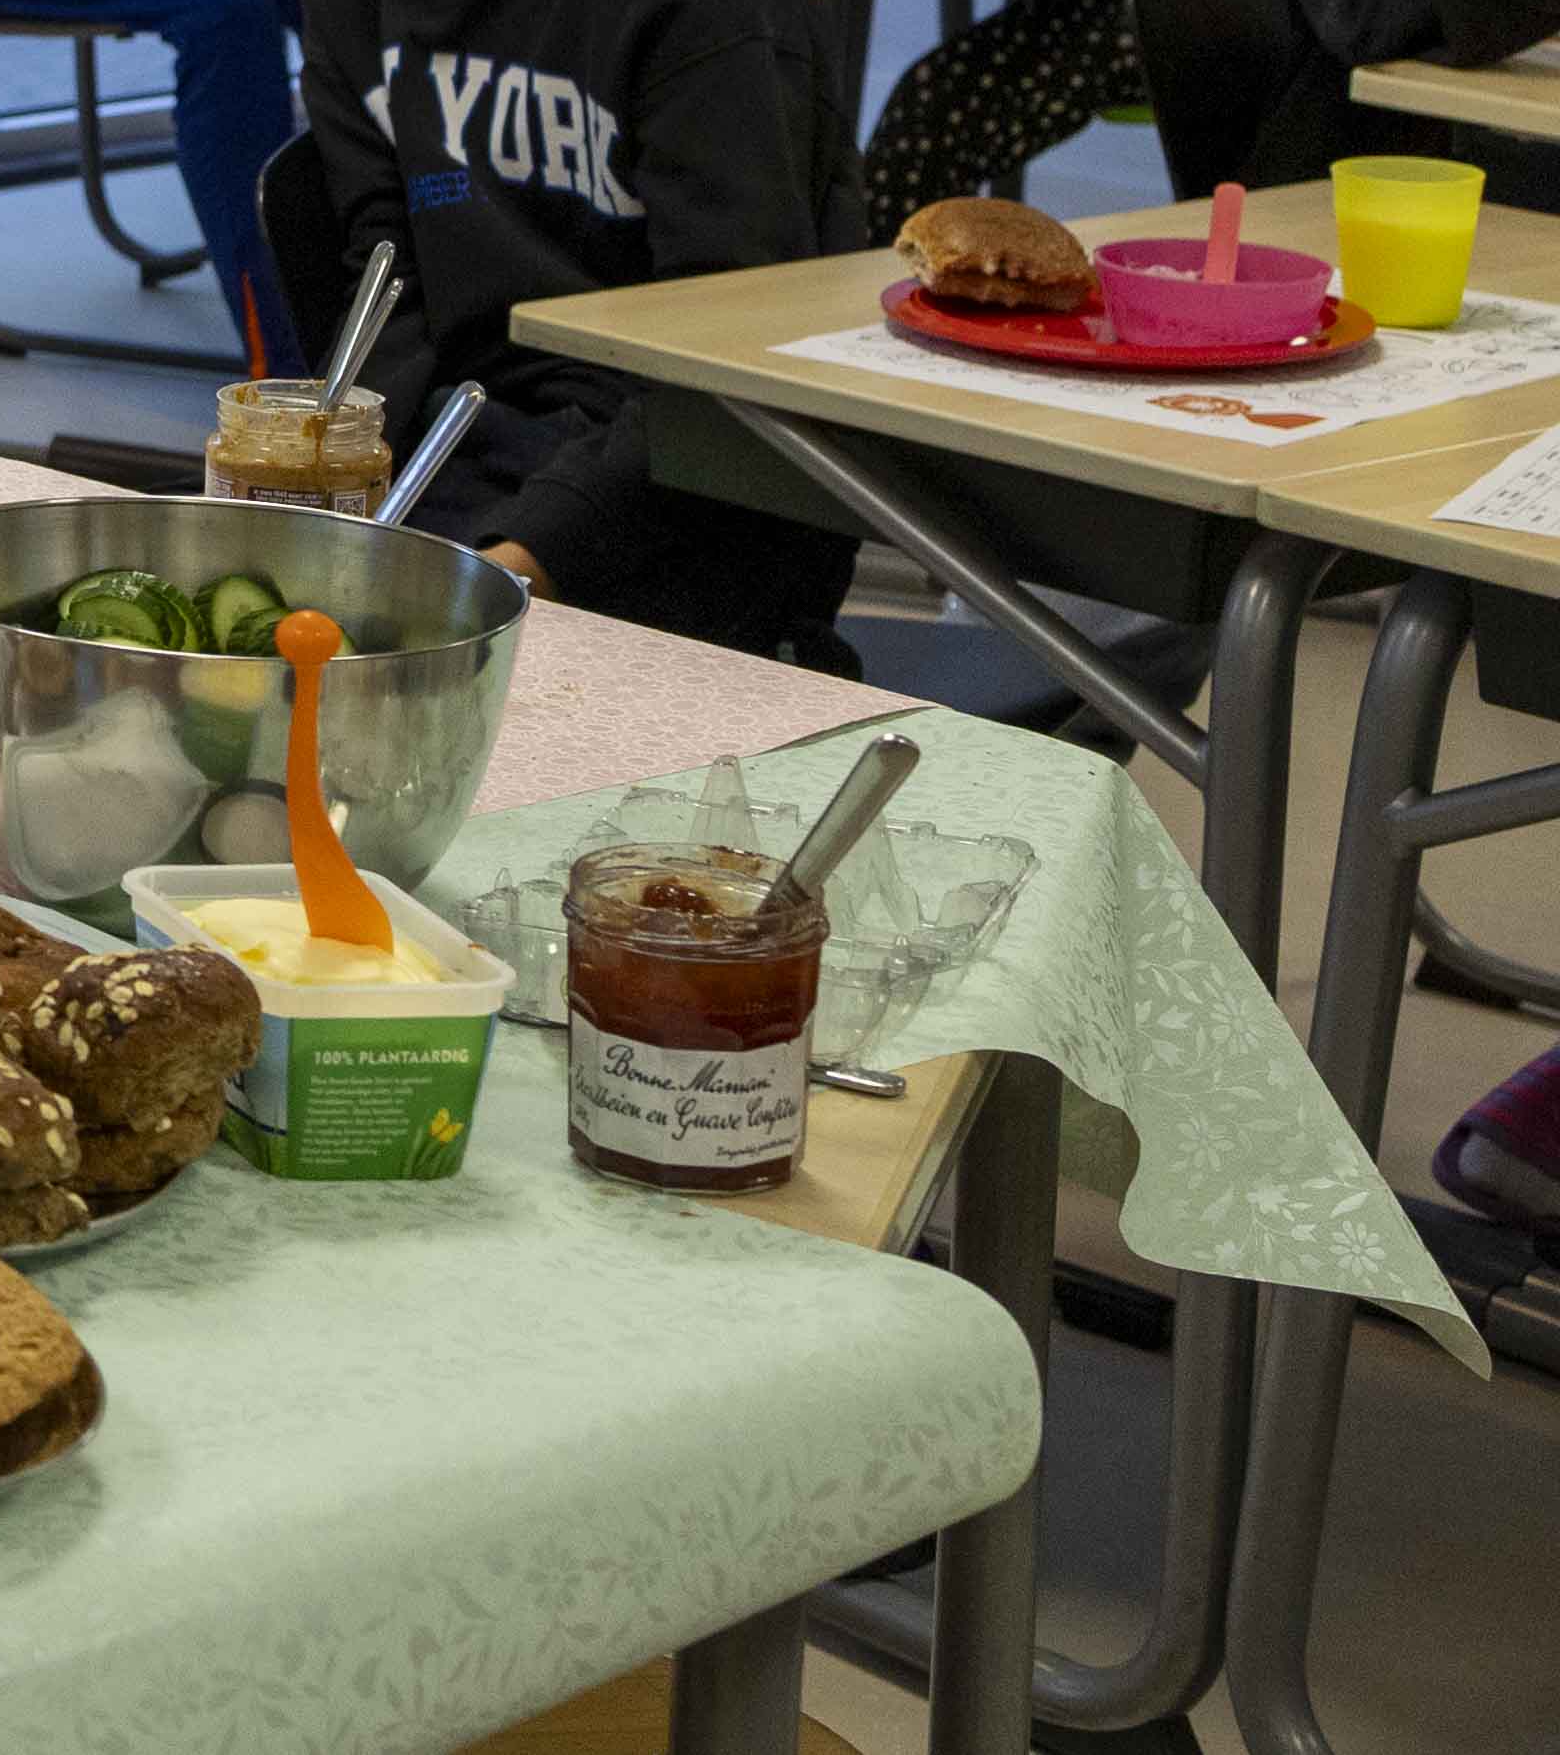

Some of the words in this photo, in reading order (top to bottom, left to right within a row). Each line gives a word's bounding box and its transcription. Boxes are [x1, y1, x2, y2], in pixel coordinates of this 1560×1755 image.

[429, 52, 648, 218] YORK
[314, 1050, 355, 1065] 100%
[359, 1047, 470, 1066] PLANTAARDIG
[603, 1044, 676, 1092] Bonne
[679, 1060, 773, 1095] Maman
